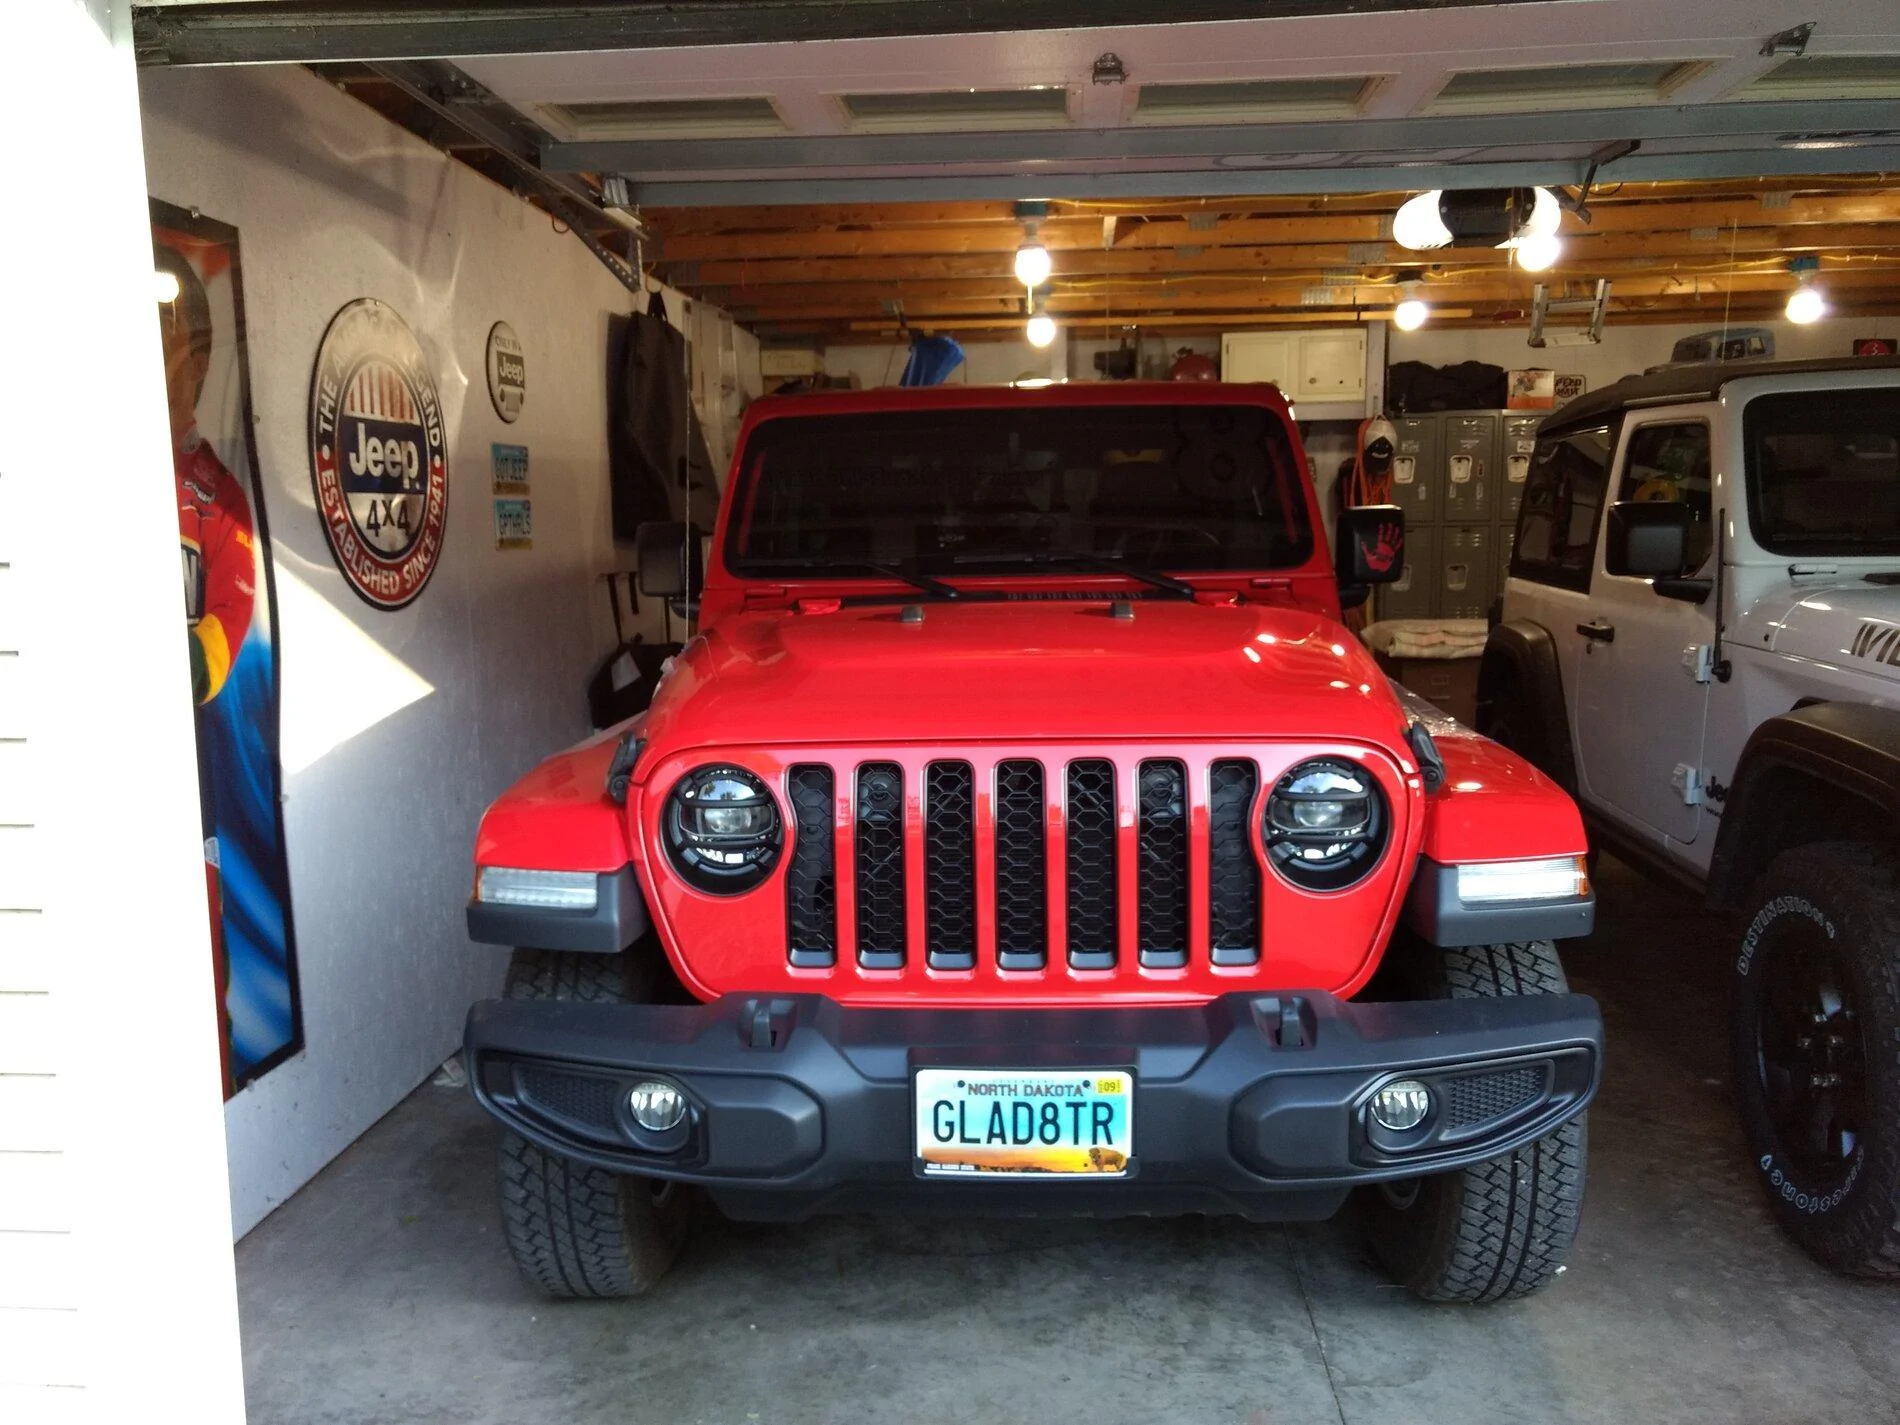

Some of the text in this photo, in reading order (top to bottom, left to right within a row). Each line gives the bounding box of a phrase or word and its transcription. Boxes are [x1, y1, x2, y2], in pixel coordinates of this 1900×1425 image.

[499, 356, 523, 385] Jeep
[319, 375, 337, 434] THE
[349, 422, 419, 490] Jeep
[321, 468, 400, 594] ESTABLISHED
[403, 536, 433, 585] SINCE
[429, 474, 443, 525] 1941
[968, 1083, 1084, 1097] NORTH DAKOTA
[1103, 1082, 1116, 1092] 09
[933, 1100, 1114, 1146] GLAD8TR
